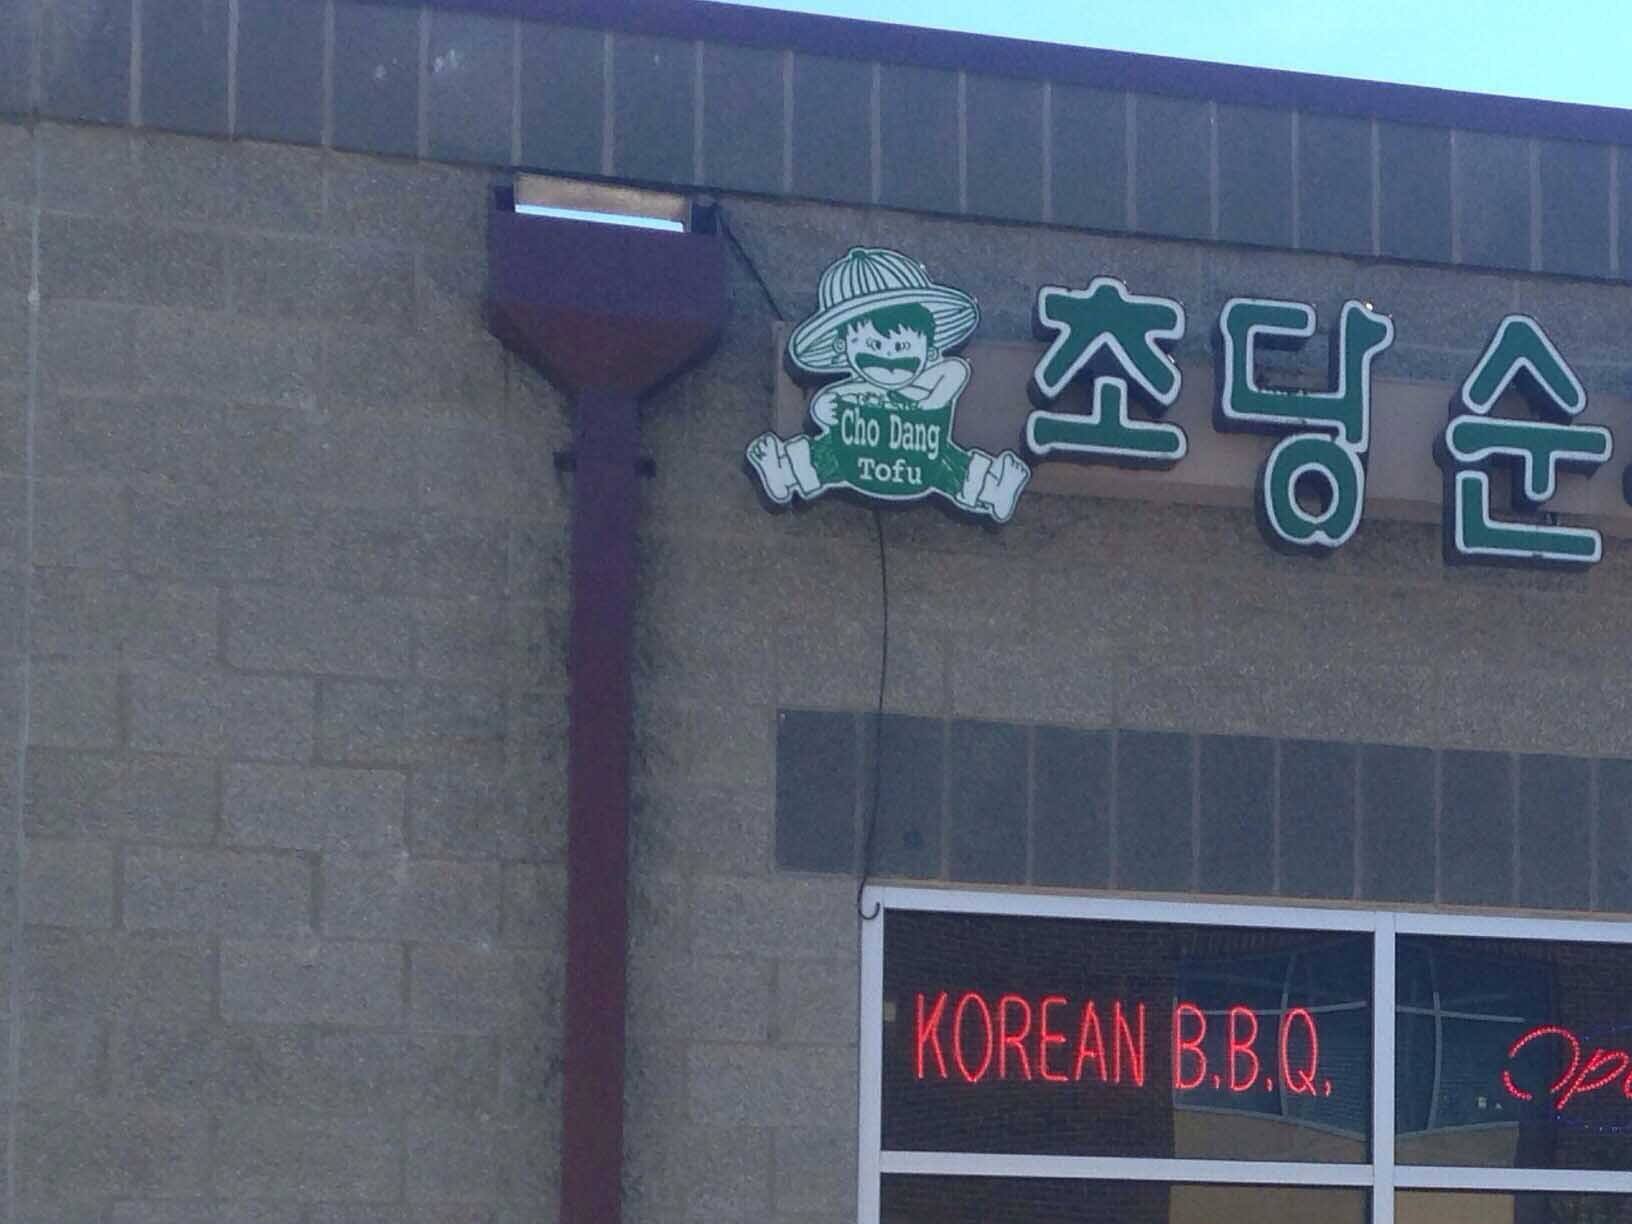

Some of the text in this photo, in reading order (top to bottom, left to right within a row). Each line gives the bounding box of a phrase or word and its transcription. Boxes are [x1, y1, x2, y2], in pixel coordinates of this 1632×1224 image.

[840, 408, 941, 460] Cho Dang
[857, 457, 923, 485] Tofu
[912, 991, 1333, 1098] KOREAN B.B.Q.
